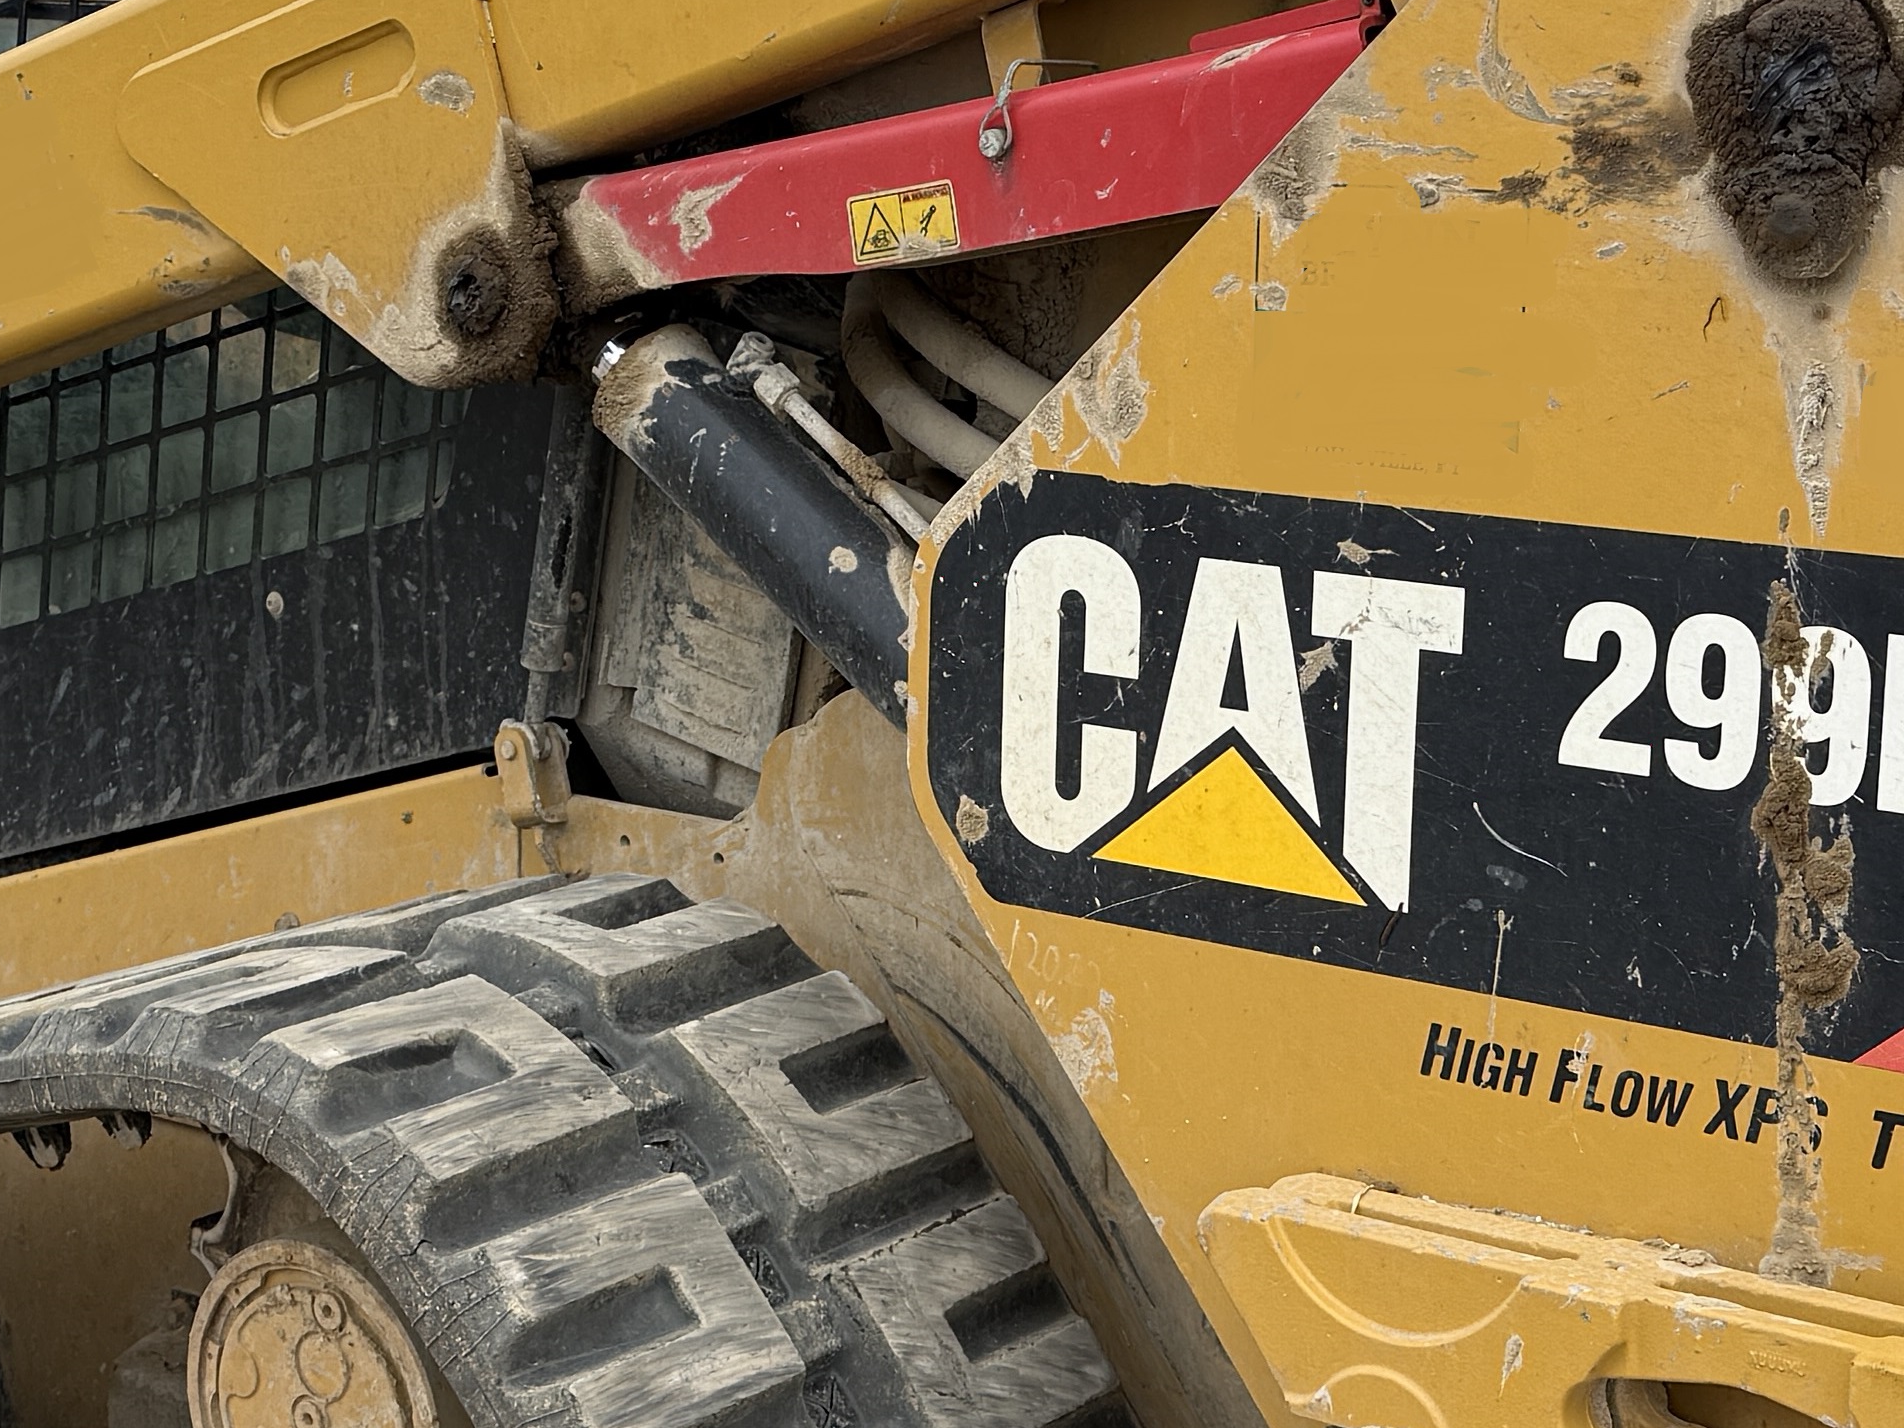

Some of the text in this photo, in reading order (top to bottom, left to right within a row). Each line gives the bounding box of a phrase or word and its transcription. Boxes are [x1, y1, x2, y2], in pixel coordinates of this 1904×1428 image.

[1000, 533, 1466, 914] CAT
[1419, 1022, 1538, 1097] HIGH
[1549, 1048, 1693, 1128] FLOW
